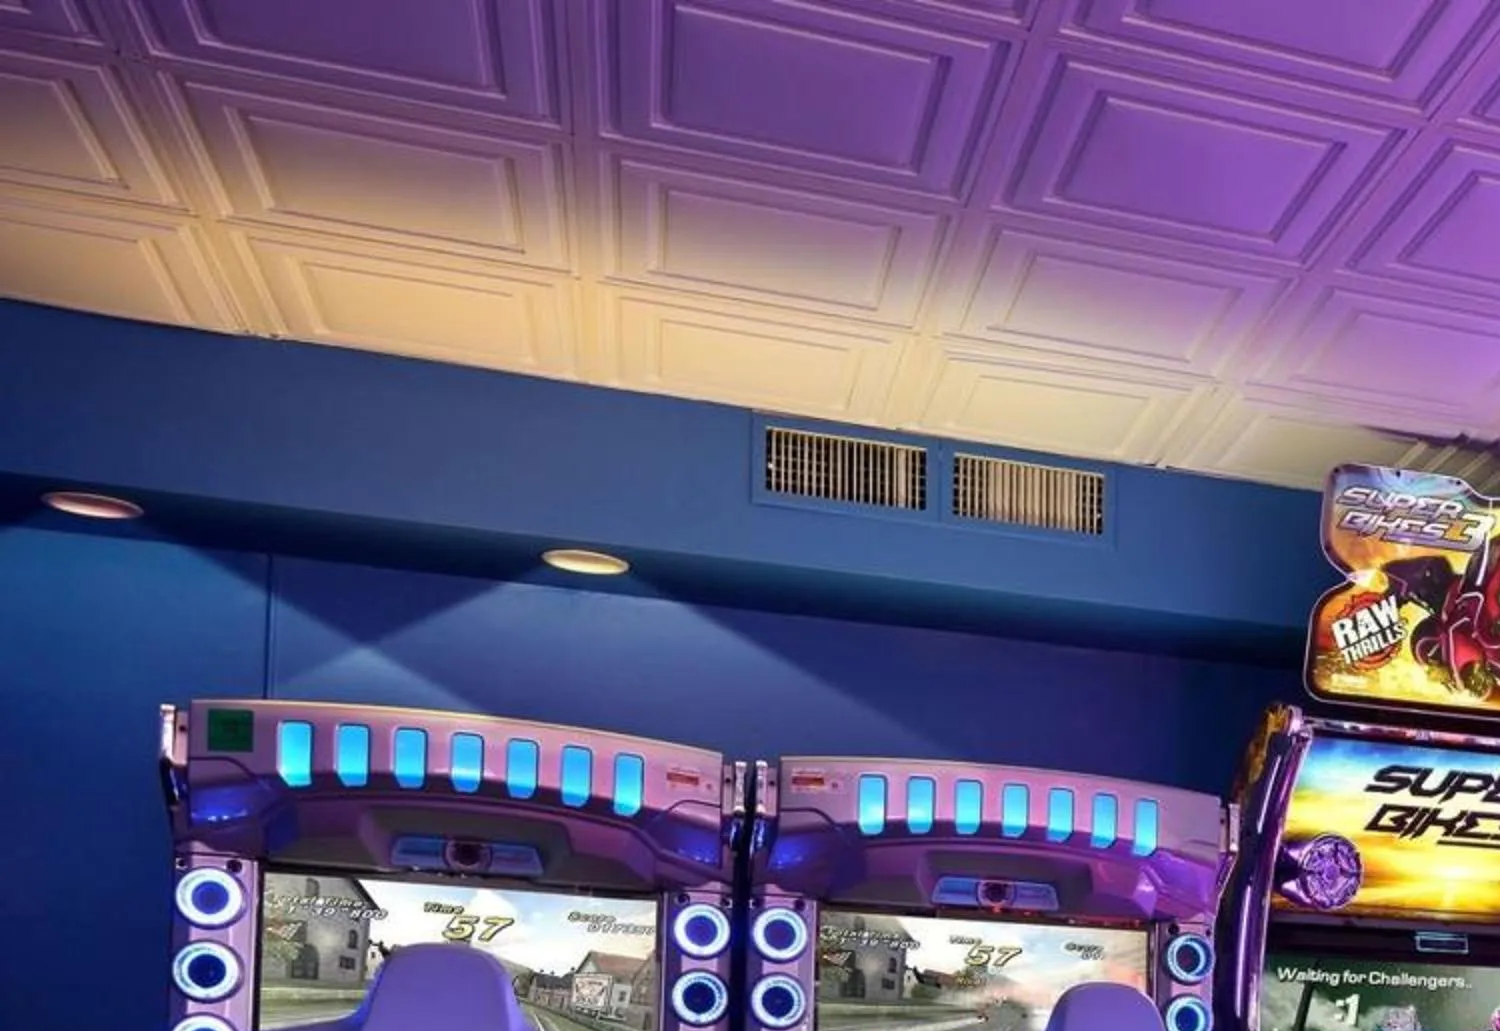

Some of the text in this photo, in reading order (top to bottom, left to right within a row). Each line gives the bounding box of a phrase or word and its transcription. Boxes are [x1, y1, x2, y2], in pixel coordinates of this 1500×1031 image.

[1337, 487, 1463, 518] SUPER
[1340, 511, 1449, 536] BIKES
[1332, 595, 1399, 648] RAW
[1342, 624, 1406, 664] THRILLS
[442, 915, 514, 941] 57
[965, 945, 1022, 967] 57
[1278, 967, 1341, 987] Waiting
[1343, 971, 1366, 984] for
